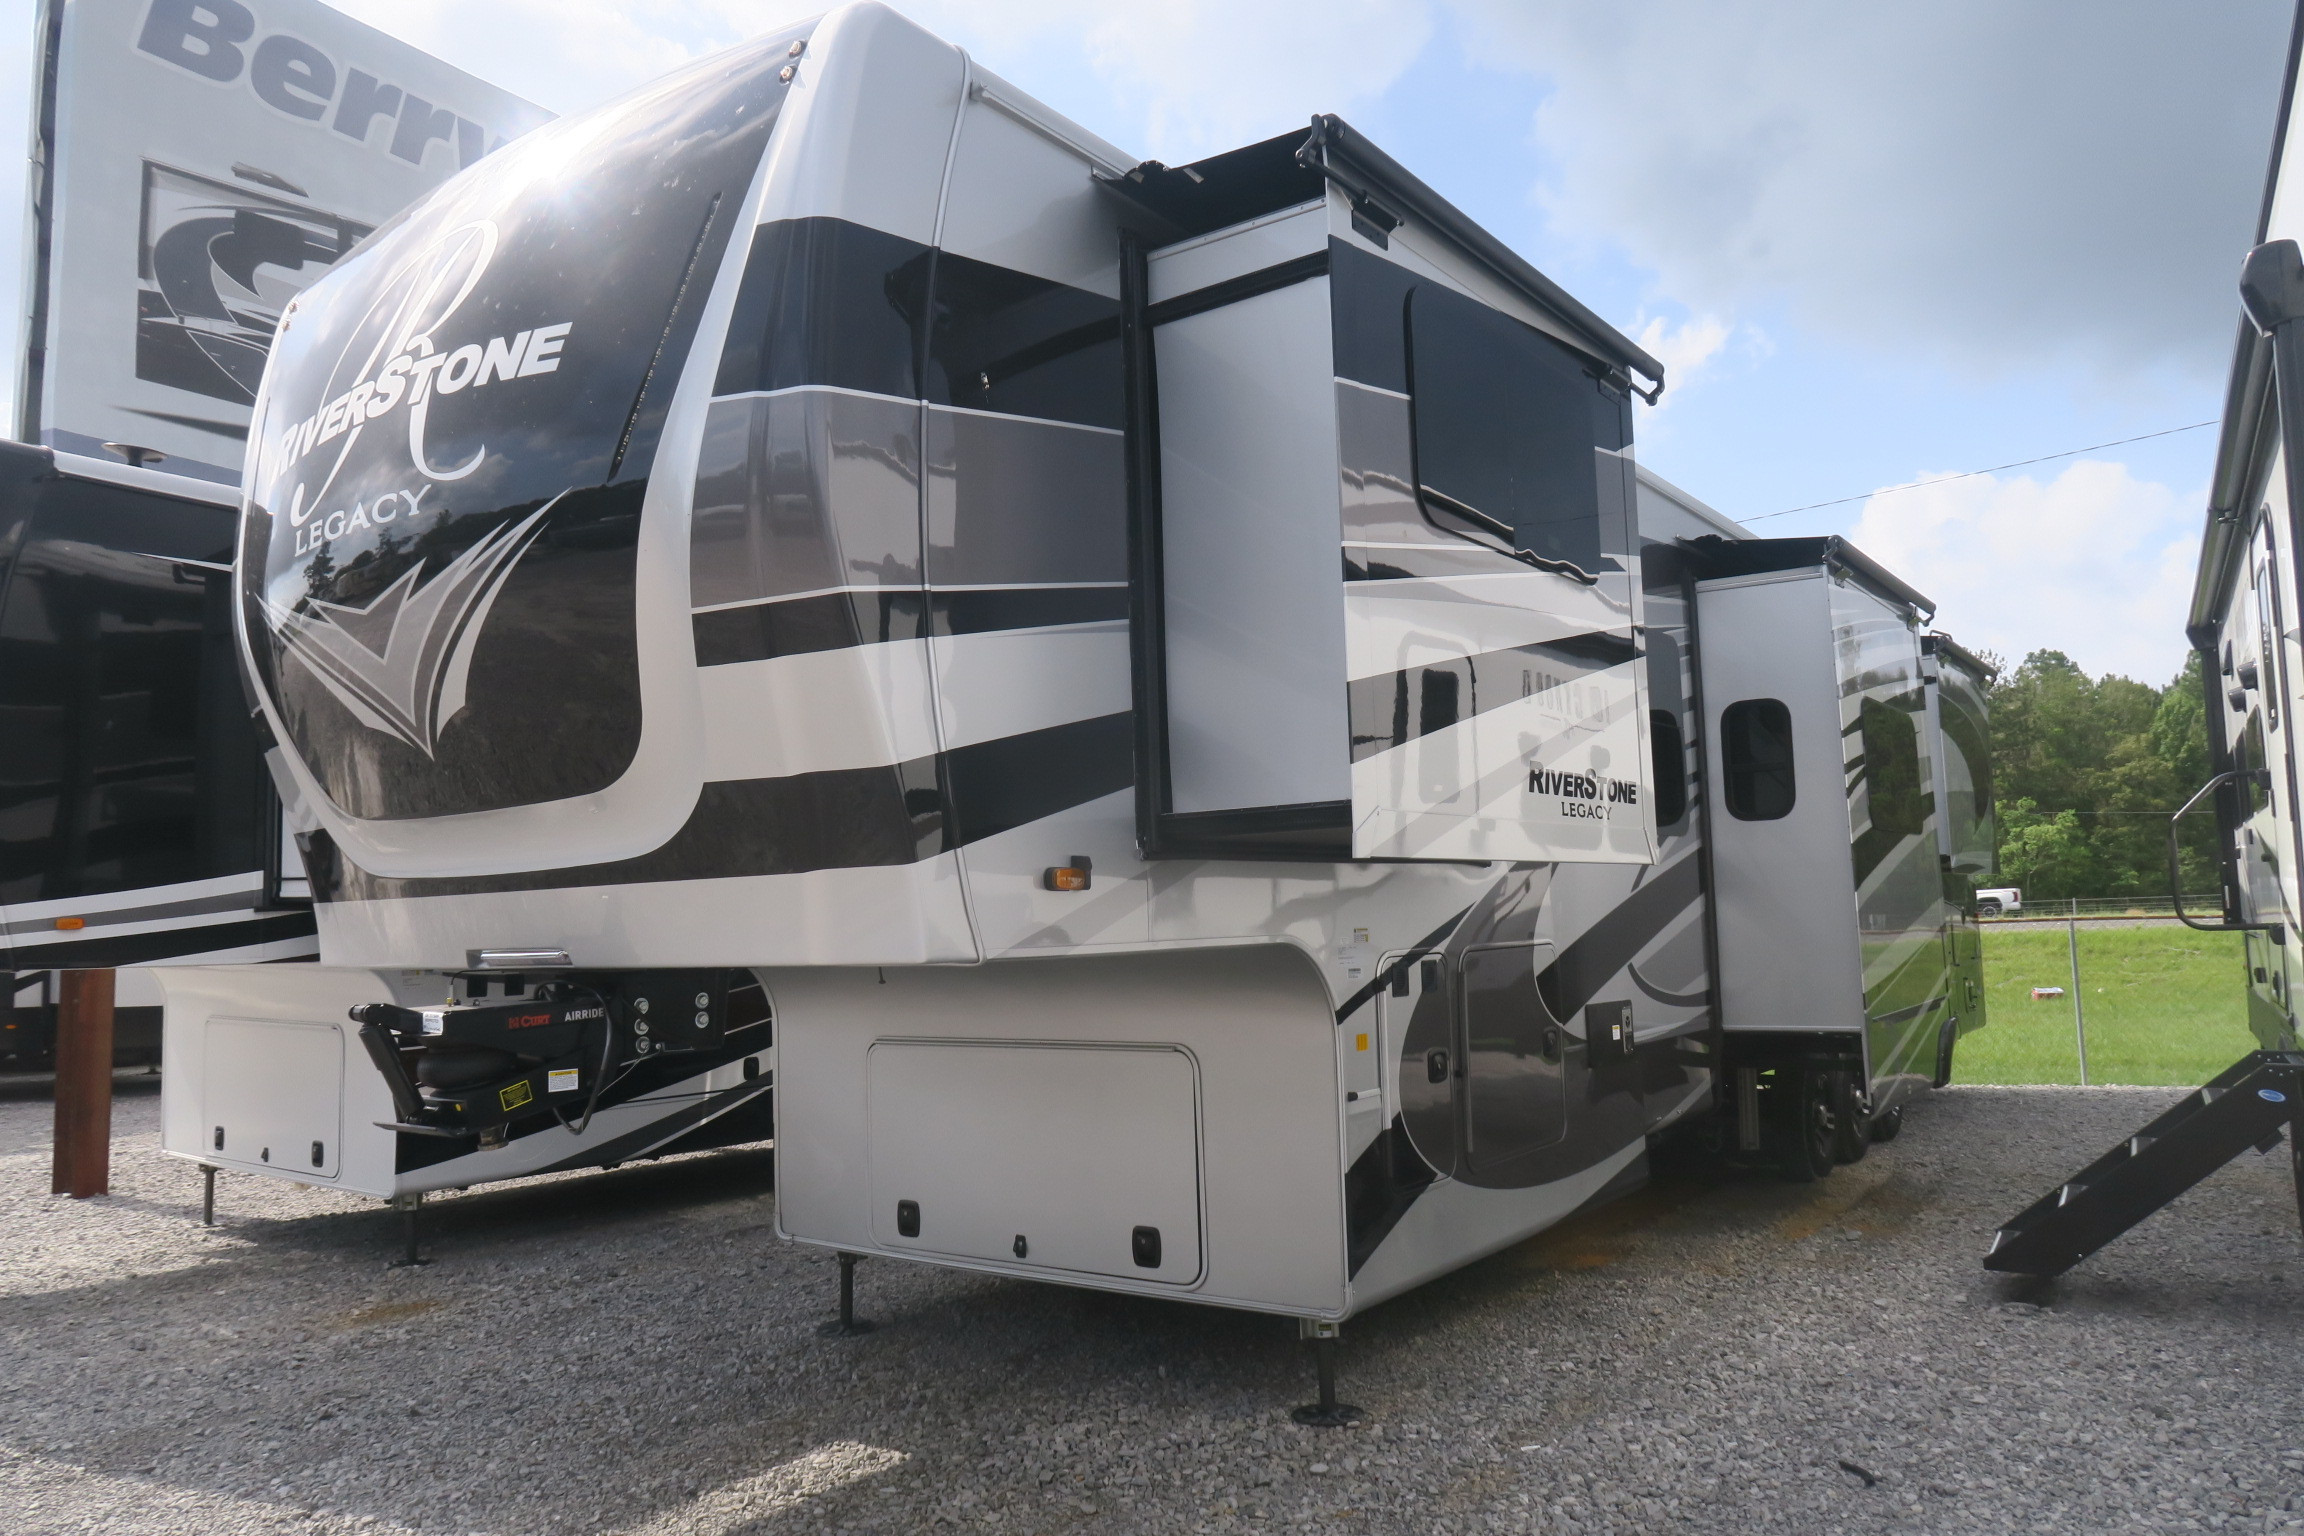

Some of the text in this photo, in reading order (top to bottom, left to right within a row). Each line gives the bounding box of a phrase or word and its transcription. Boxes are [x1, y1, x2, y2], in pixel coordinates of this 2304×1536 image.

[270, 322, 573, 485] RIVERSTONE
[295, 484, 431, 557] LEGACY
[1529, 760, 1637, 805] RIVERSTONE
[1561, 801, 1612, 820] LEGACY
[564, 1008, 604, 1022] AIRRIDE
